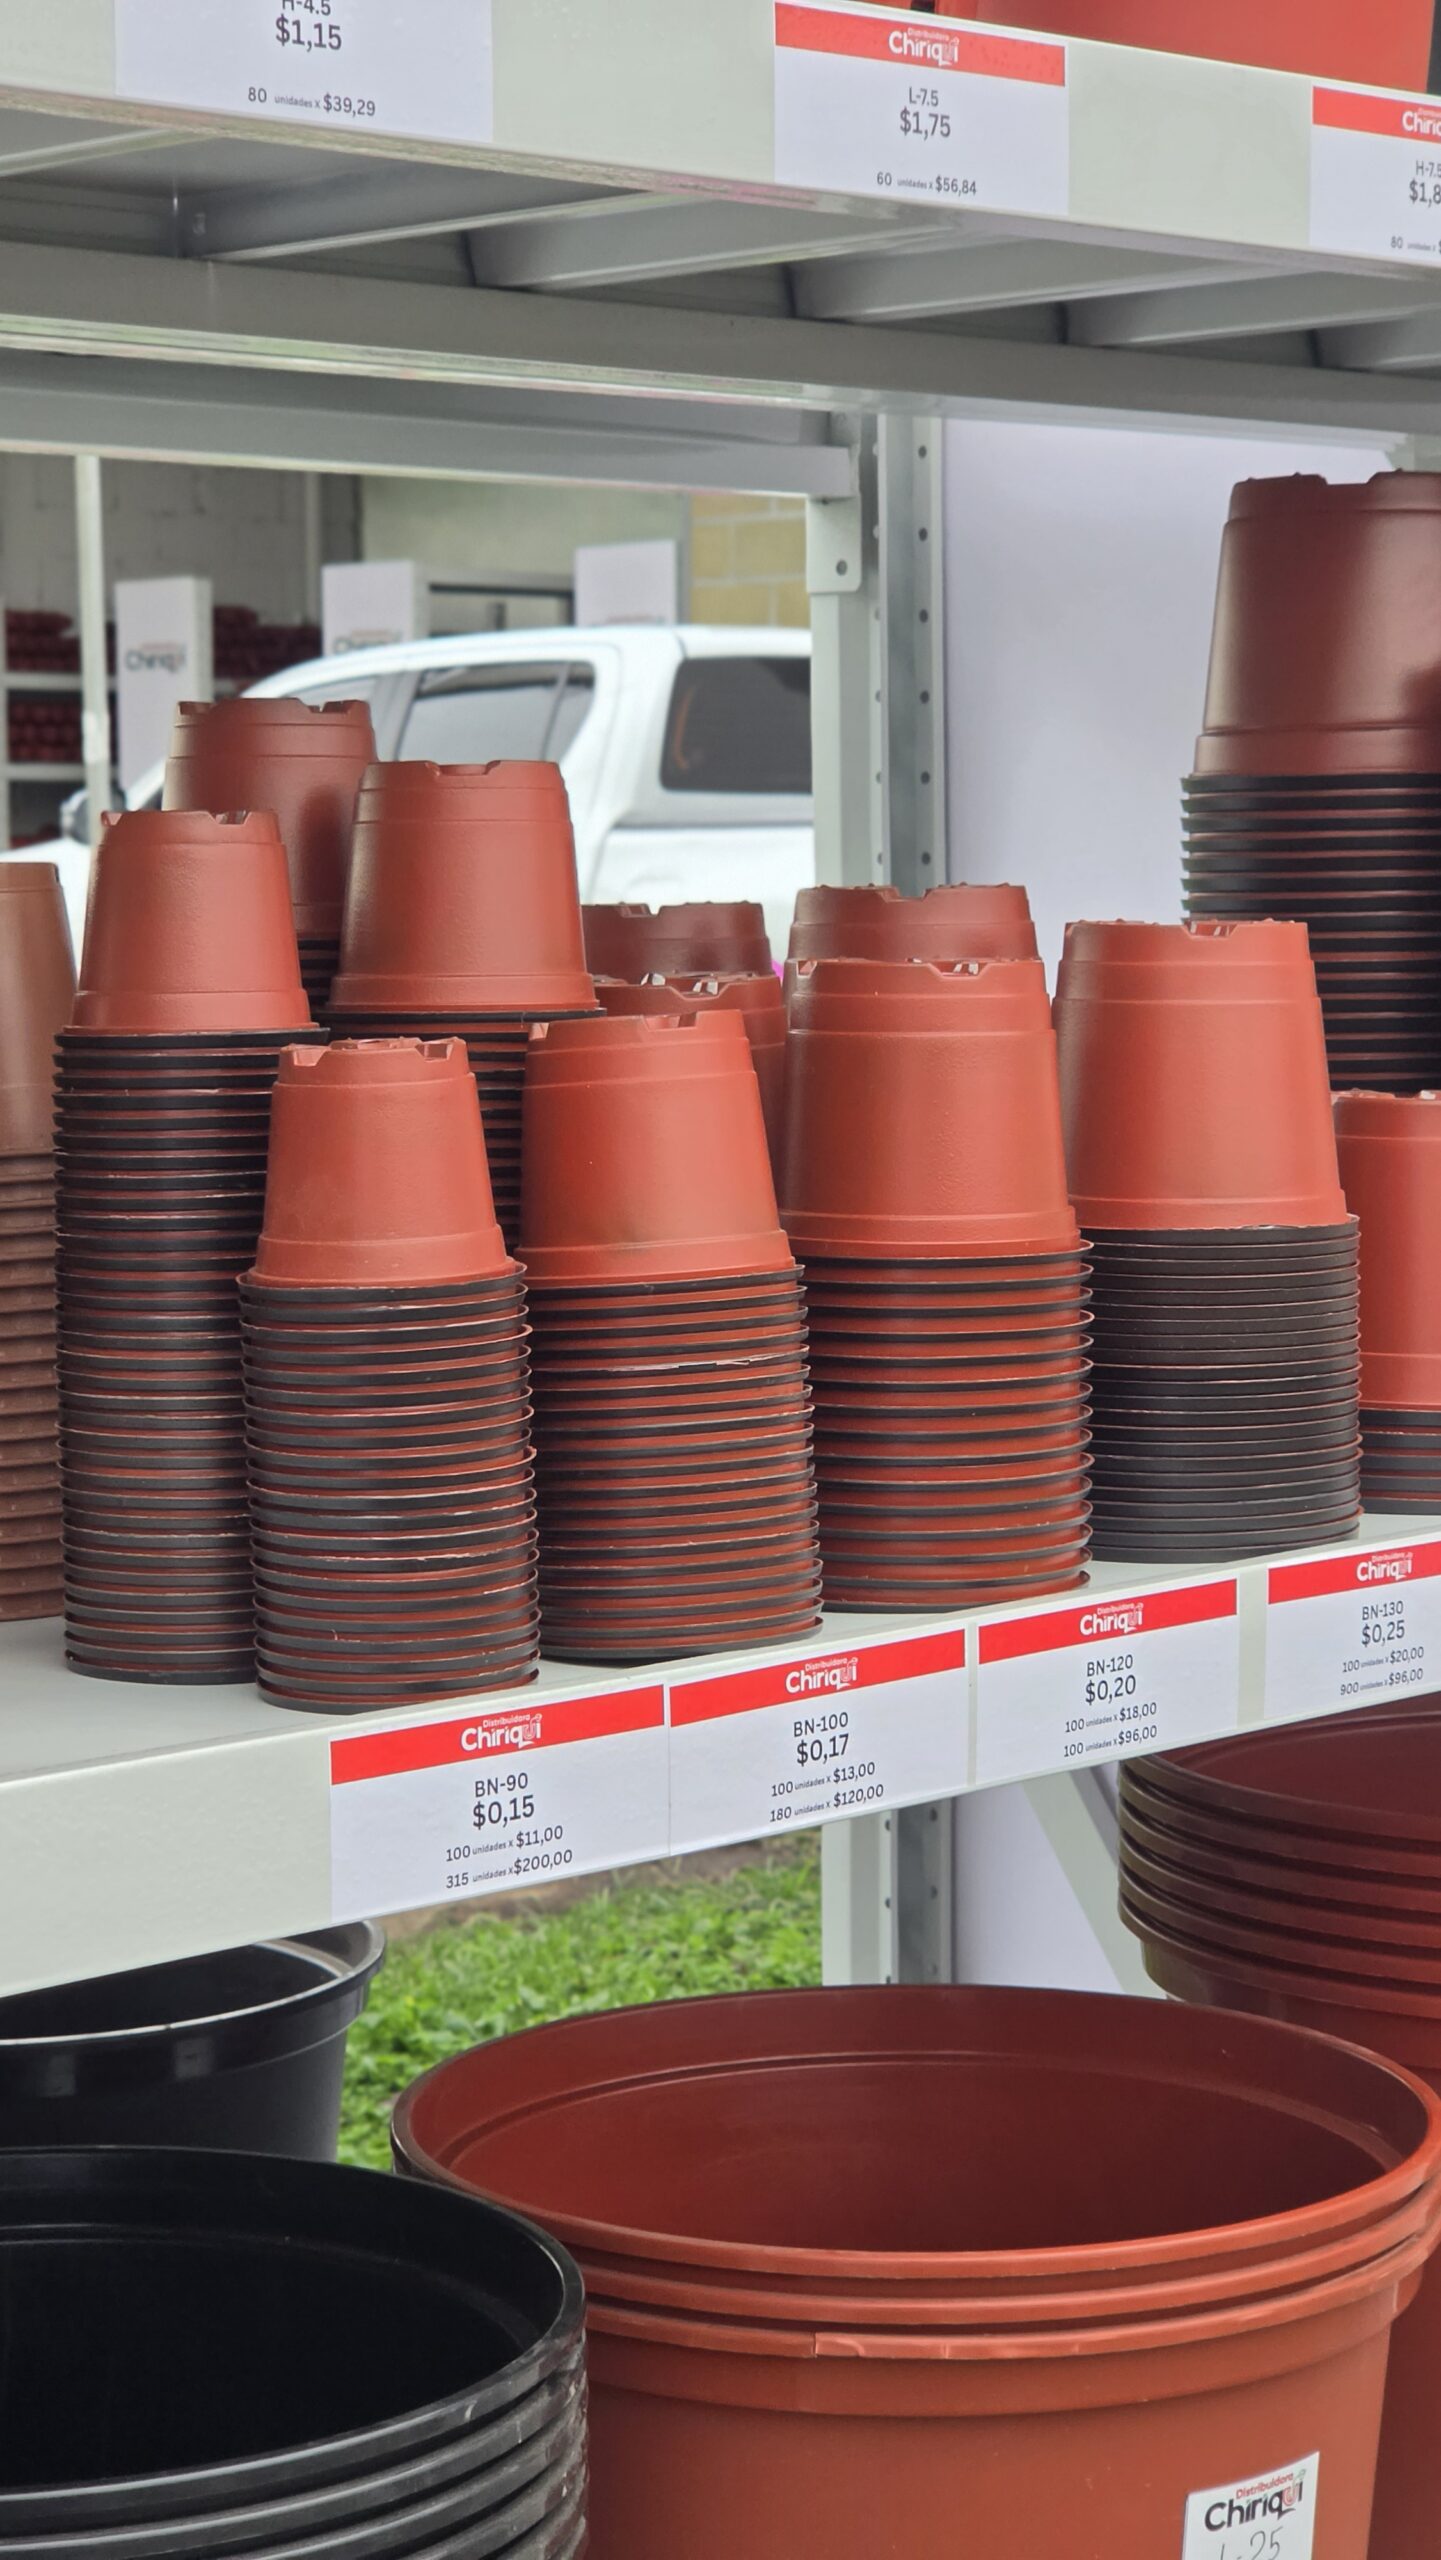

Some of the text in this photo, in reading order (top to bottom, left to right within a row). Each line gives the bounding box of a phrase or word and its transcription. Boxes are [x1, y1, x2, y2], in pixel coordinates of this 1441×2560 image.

[275, 13, 342, 52] $1,15
[247, 86, 267, 103] 80
[274, 95, 312, 109] unidades
[323, 91, 376, 117] $39,29
[909, 87, 939, 107] L-7.5
[899, 106, 951, 140] $1,75
[877, 171, 892, 186] 60
[935, 174, 977, 197] $56,84
[1362, 1600, 1404, 1621] BN-130
[1361, 1619, 1406, 1648] $0,25
[1086, 1654, 1133, 1677] BN-120
[1342, 1659, 1360, 1673] 100
[1390, 1646, 1424, 1664] $20,00
[1085, 1674, 1136, 1706] $0,20
[1340, 1681, 1359, 1697] 900
[1389, 1668, 1424, 1686] $96,00
[482, 1714, 531, 1728] Distribuidora
[793, 1711, 849, 1738] BN-100
[1065, 1718, 1085, 1733] 100
[1119, 1702, 1157, 1722] $18,00
[796, 1733, 849, 1767] $0,17
[1064, 1742, 1084, 1758] 100
[1118, 1725, 1157, 1746] $96,00
[474, 1772, 529, 1798] BN-90
[771, 1781, 793, 1797] 100
[794, 1778, 825, 1790] unidades
[833, 1761, 875, 1784] $13,00
[472, 1794, 535, 1831] $0,15
[770, 1806, 792, 1823] 180
[794, 1803, 824, 1816] unidades
[833, 1784, 884, 1808] $120,00
[446, 1845, 471, 1862] 100
[472, 1842, 507, 1855] unidades
[516, 1825, 563, 1849] $11,00
[446, 1872, 469, 1889] 315
[472, 1869, 507, 1883] unidades
[514, 1849, 573, 1875] $200,00
[1235, 2472, 1294, 2500] Distribuidora
